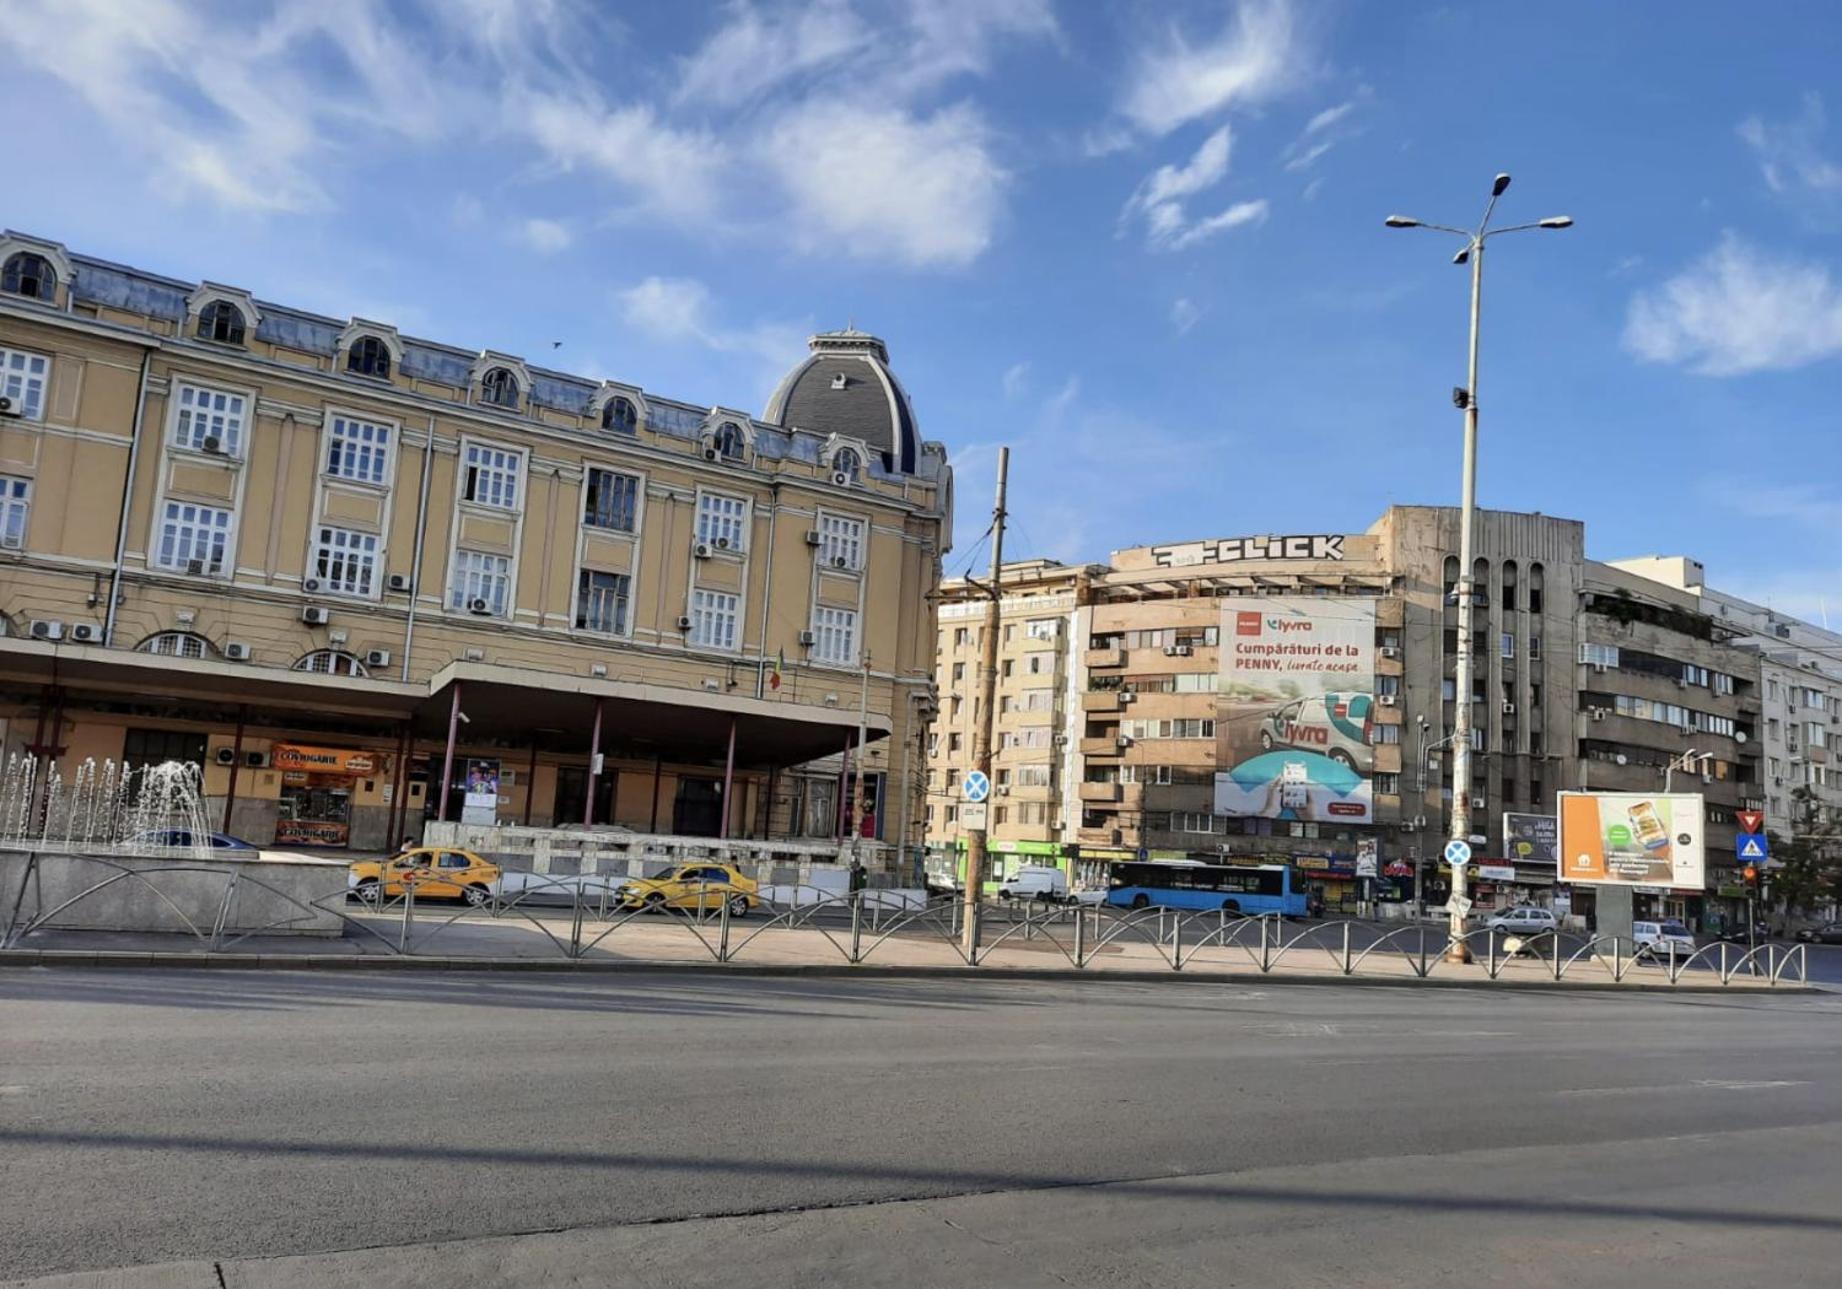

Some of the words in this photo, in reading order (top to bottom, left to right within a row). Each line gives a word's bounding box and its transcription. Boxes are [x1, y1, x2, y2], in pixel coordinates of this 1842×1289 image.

[1278, 619, 1312, 633] lyvra
[1236, 642, 1321, 656] Cumpărături
[1325, 644, 1342, 656] de
[1346, 645, 1359, 656] la
[1235, 658, 1283, 671] PENNY,
[1284, 724, 1329, 745] lyvra
